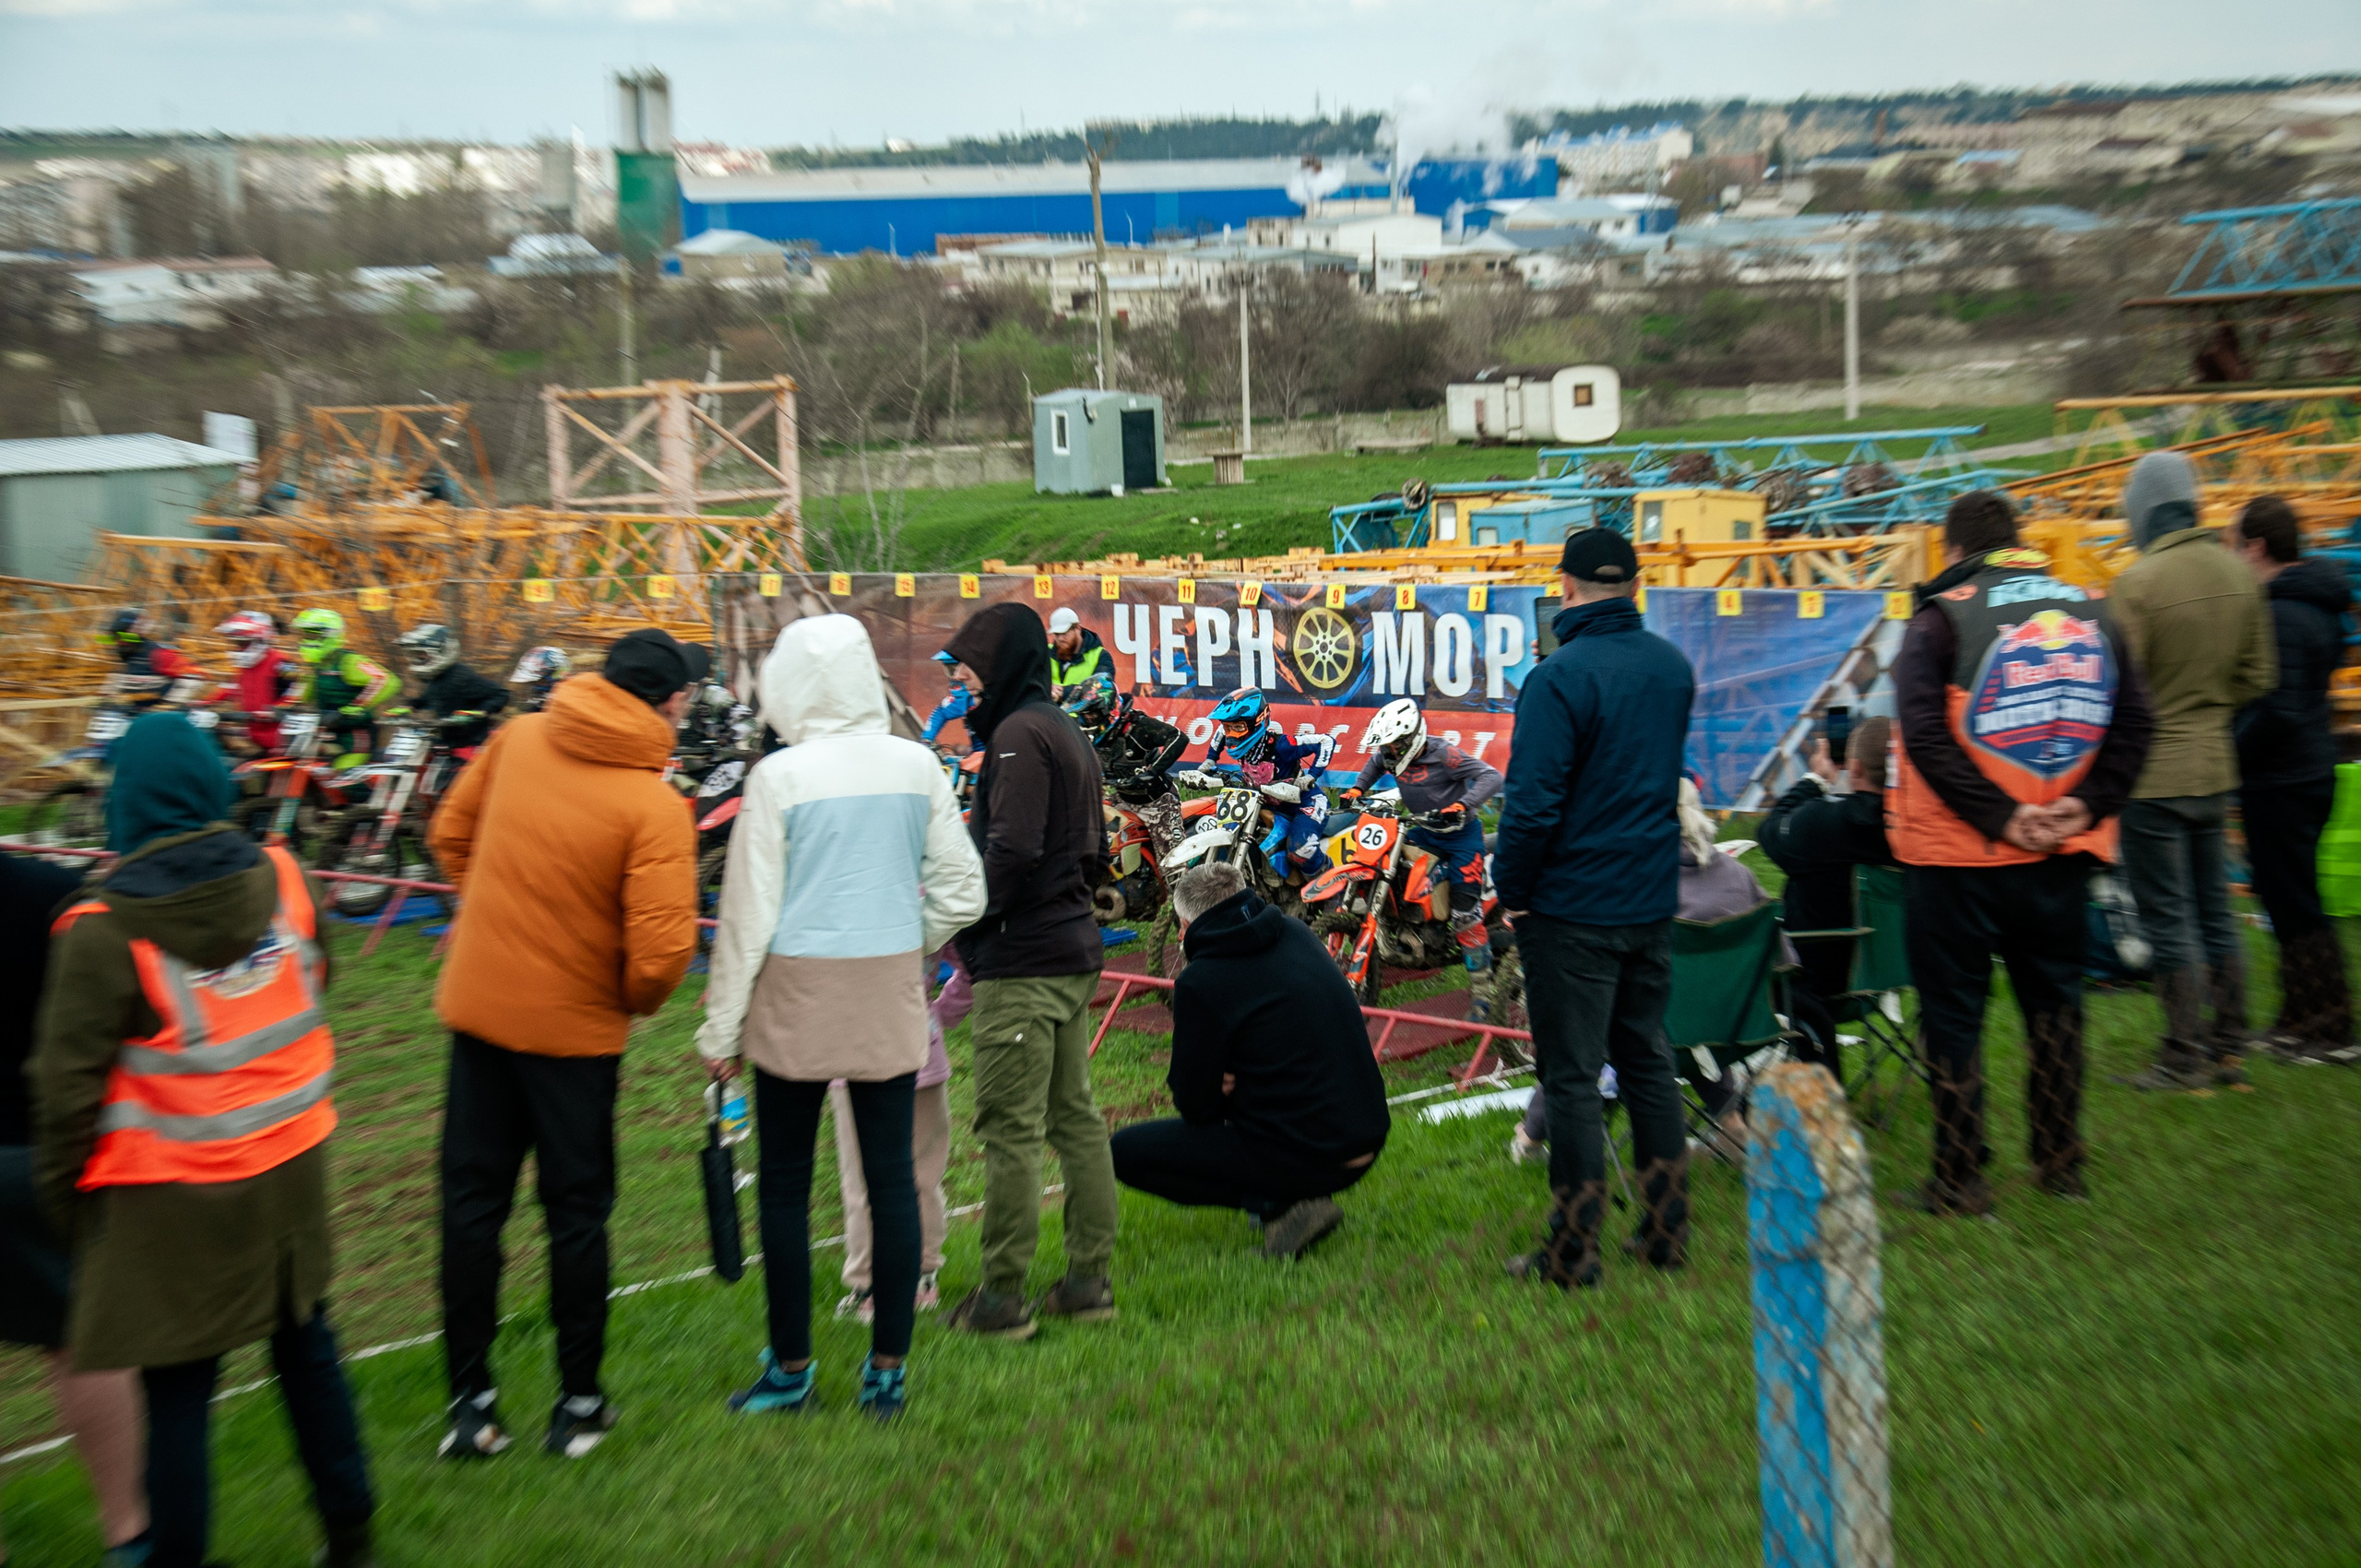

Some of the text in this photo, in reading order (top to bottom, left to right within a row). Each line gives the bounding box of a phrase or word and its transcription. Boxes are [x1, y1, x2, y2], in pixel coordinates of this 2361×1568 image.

[963, 579, 976, 595] 14
[1039, 579, 1050, 595] 13
[1104, 580, 1116, 596] 12
[1181, 585, 1192, 600] 11
[1245, 587, 1258, 600] 10
[1333, 589, 1340, 604] 9
[1402, 590, 1409, 605] 8
[1474, 591, 1481, 607] 7
[1113, 602, 1525, 699] ЧЕРН МОР
[1217, 790, 1251, 821] 68
[1198, 817, 1217, 833] 120
[1361, 827, 1383, 847] 26
